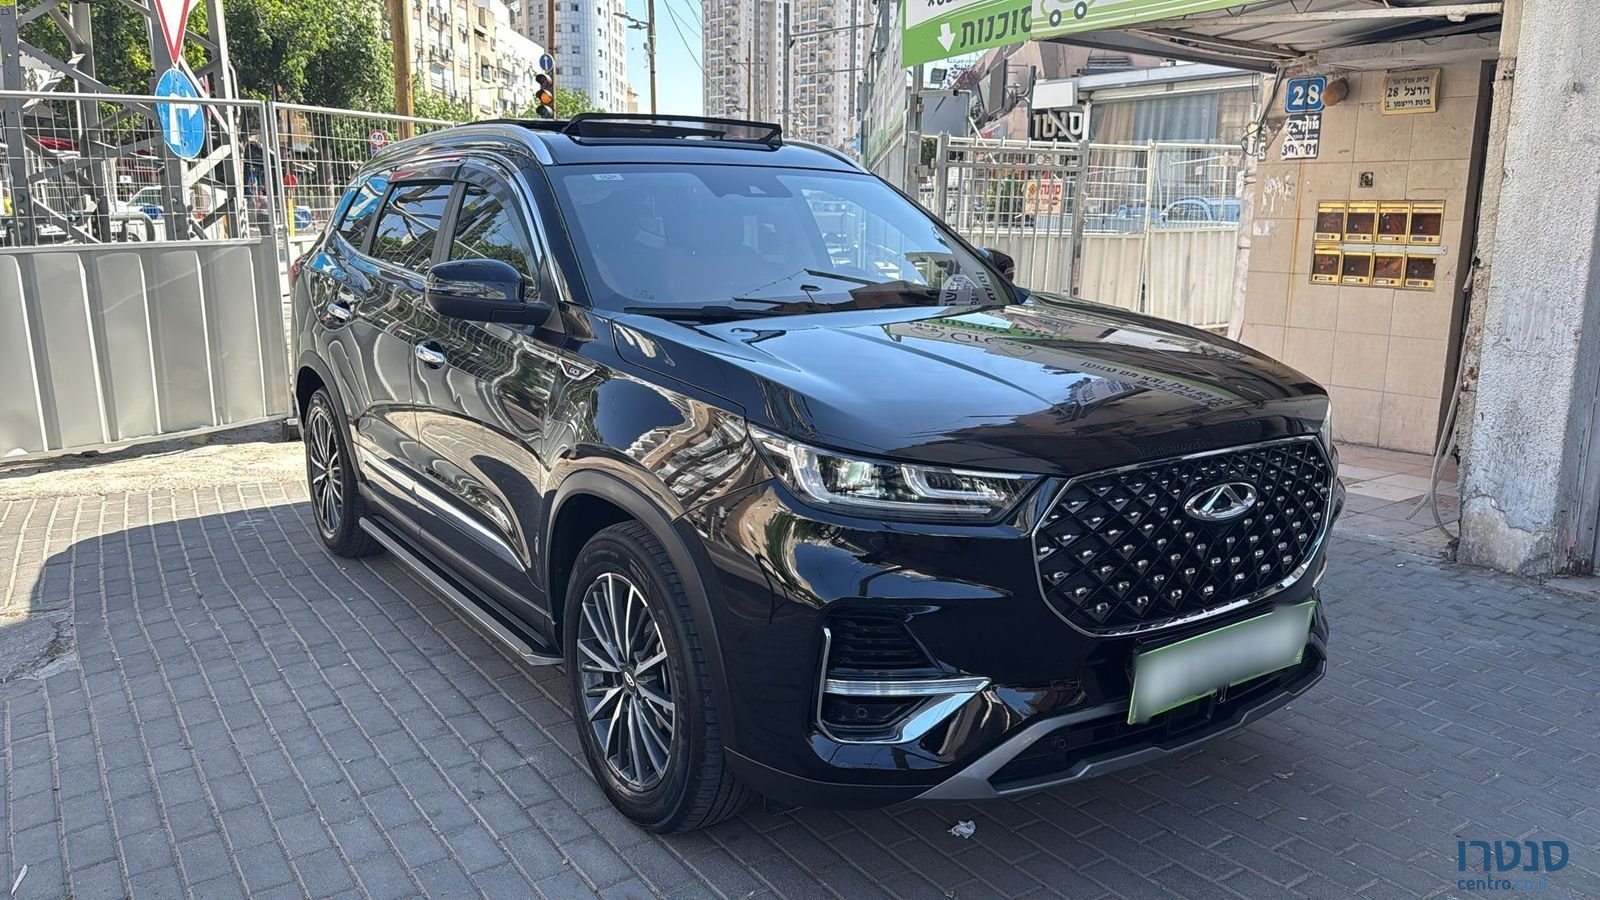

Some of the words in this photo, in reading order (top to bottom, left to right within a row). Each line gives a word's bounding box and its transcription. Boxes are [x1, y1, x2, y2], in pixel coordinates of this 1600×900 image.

[960, 5, 1032, 48] סוכנות
[1292, 85, 1319, 105] 28
[1387, 87, 1399, 97] 28
[1404, 86, 1430, 96] הרצל
